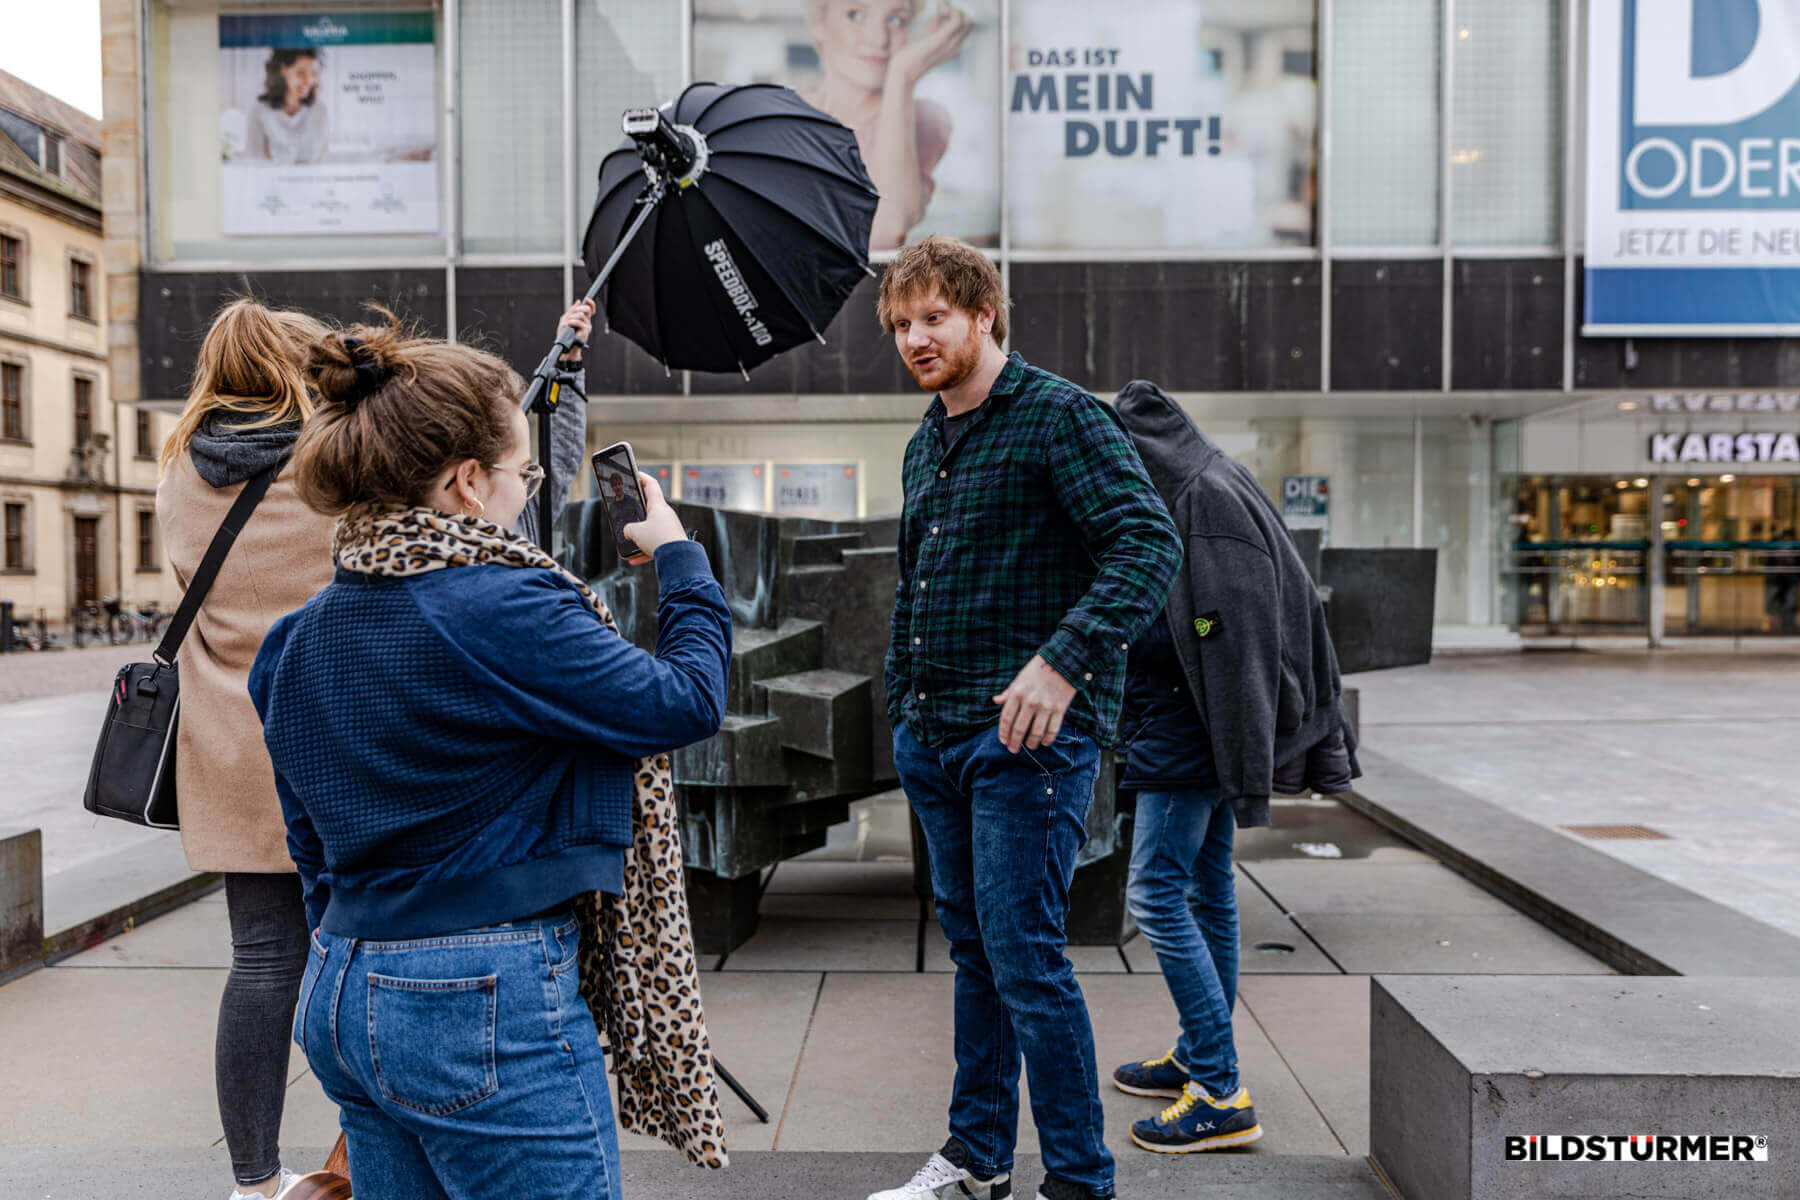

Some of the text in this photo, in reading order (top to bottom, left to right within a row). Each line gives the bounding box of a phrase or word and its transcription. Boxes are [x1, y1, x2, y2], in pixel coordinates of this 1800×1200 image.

[1028, 49, 1119, 67] DAS IST
[1010, 73, 1153, 112] MEIN
[1064, 116, 1221, 157] DUFT!
[1614, 228, 1800, 257] JETZT DIE NE
